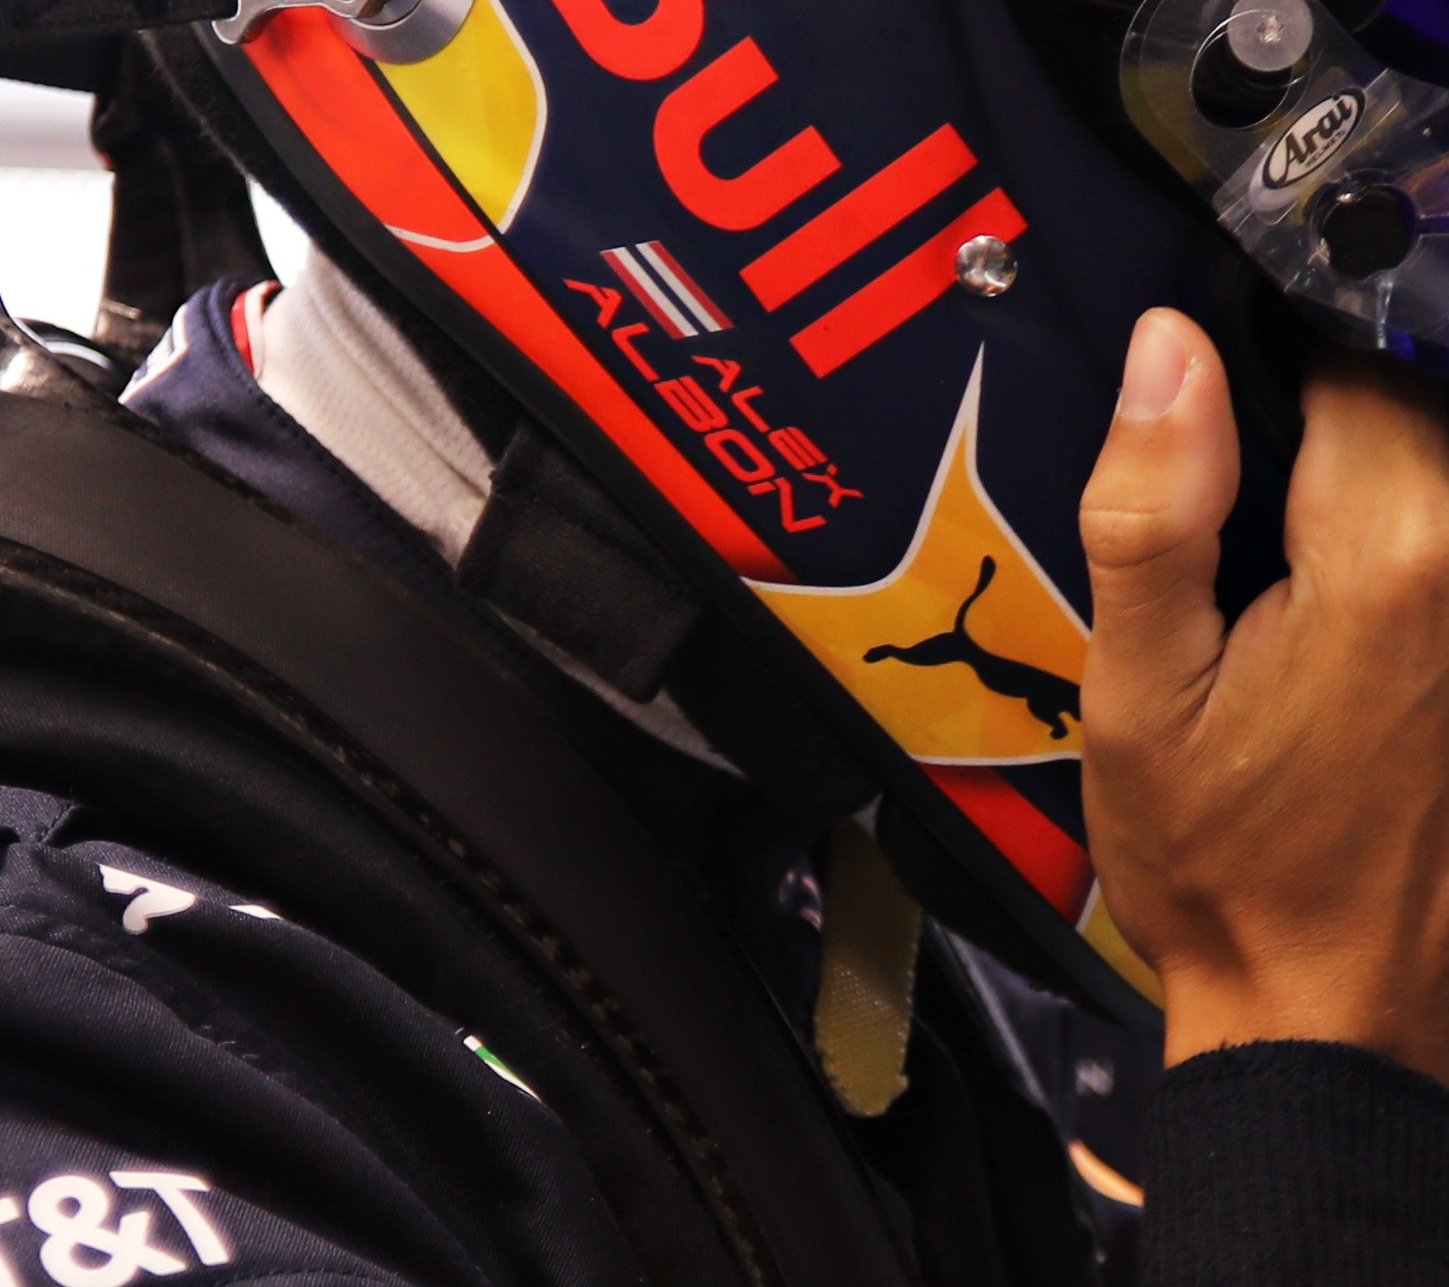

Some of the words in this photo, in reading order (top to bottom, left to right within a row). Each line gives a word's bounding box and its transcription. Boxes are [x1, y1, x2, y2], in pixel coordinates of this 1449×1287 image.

[1277, 98, 1352, 185] Arai
[563, 279, 828, 534] ALBON
[691, 355, 865, 508] ALEX
